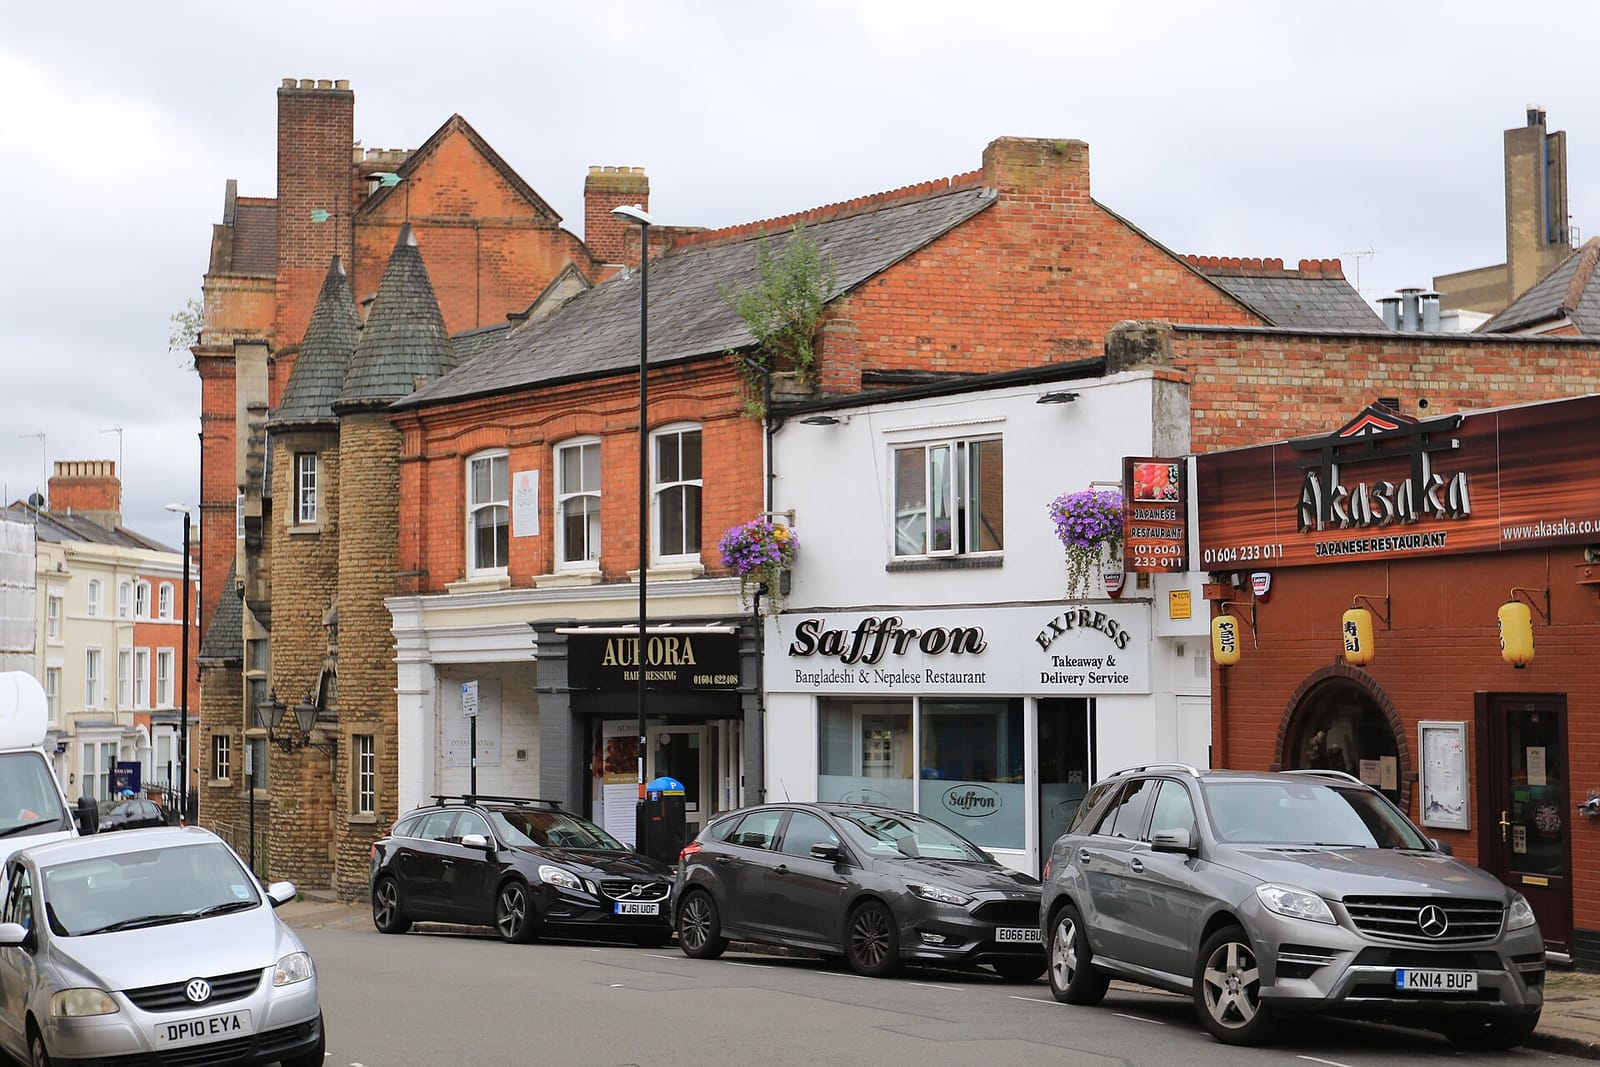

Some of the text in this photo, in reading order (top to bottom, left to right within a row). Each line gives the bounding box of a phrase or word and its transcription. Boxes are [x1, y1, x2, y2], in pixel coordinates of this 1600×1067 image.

[1296, 450, 1472, 534] Akasaka
[1134, 508, 1176, 520] JAPANESE
[1131, 527, 1182, 539] RESTAURANT
[1134, 545, 1181, 555] (01604)
[1204, 543, 1283, 563] 01604 233 011
[1315, 532, 1447, 557] JAPANESE RESTAURANT
[1134, 557, 1182, 567] 233 011
[1035, 608, 1131, 653] EXPRESS
[788, 616, 987, 665] Saffron
[1052, 655, 1116, 669] Takeaway &
[795, 668, 986, 687] Bangladeshi & Nepalese Restaurant
[1040, 672, 1129, 686] Delivery Service
[949, 791, 995, 809] Saffron
[1409, 972, 1473, 988] KN14 BUP
[167, 1014, 241, 1041] DP10 EYA
